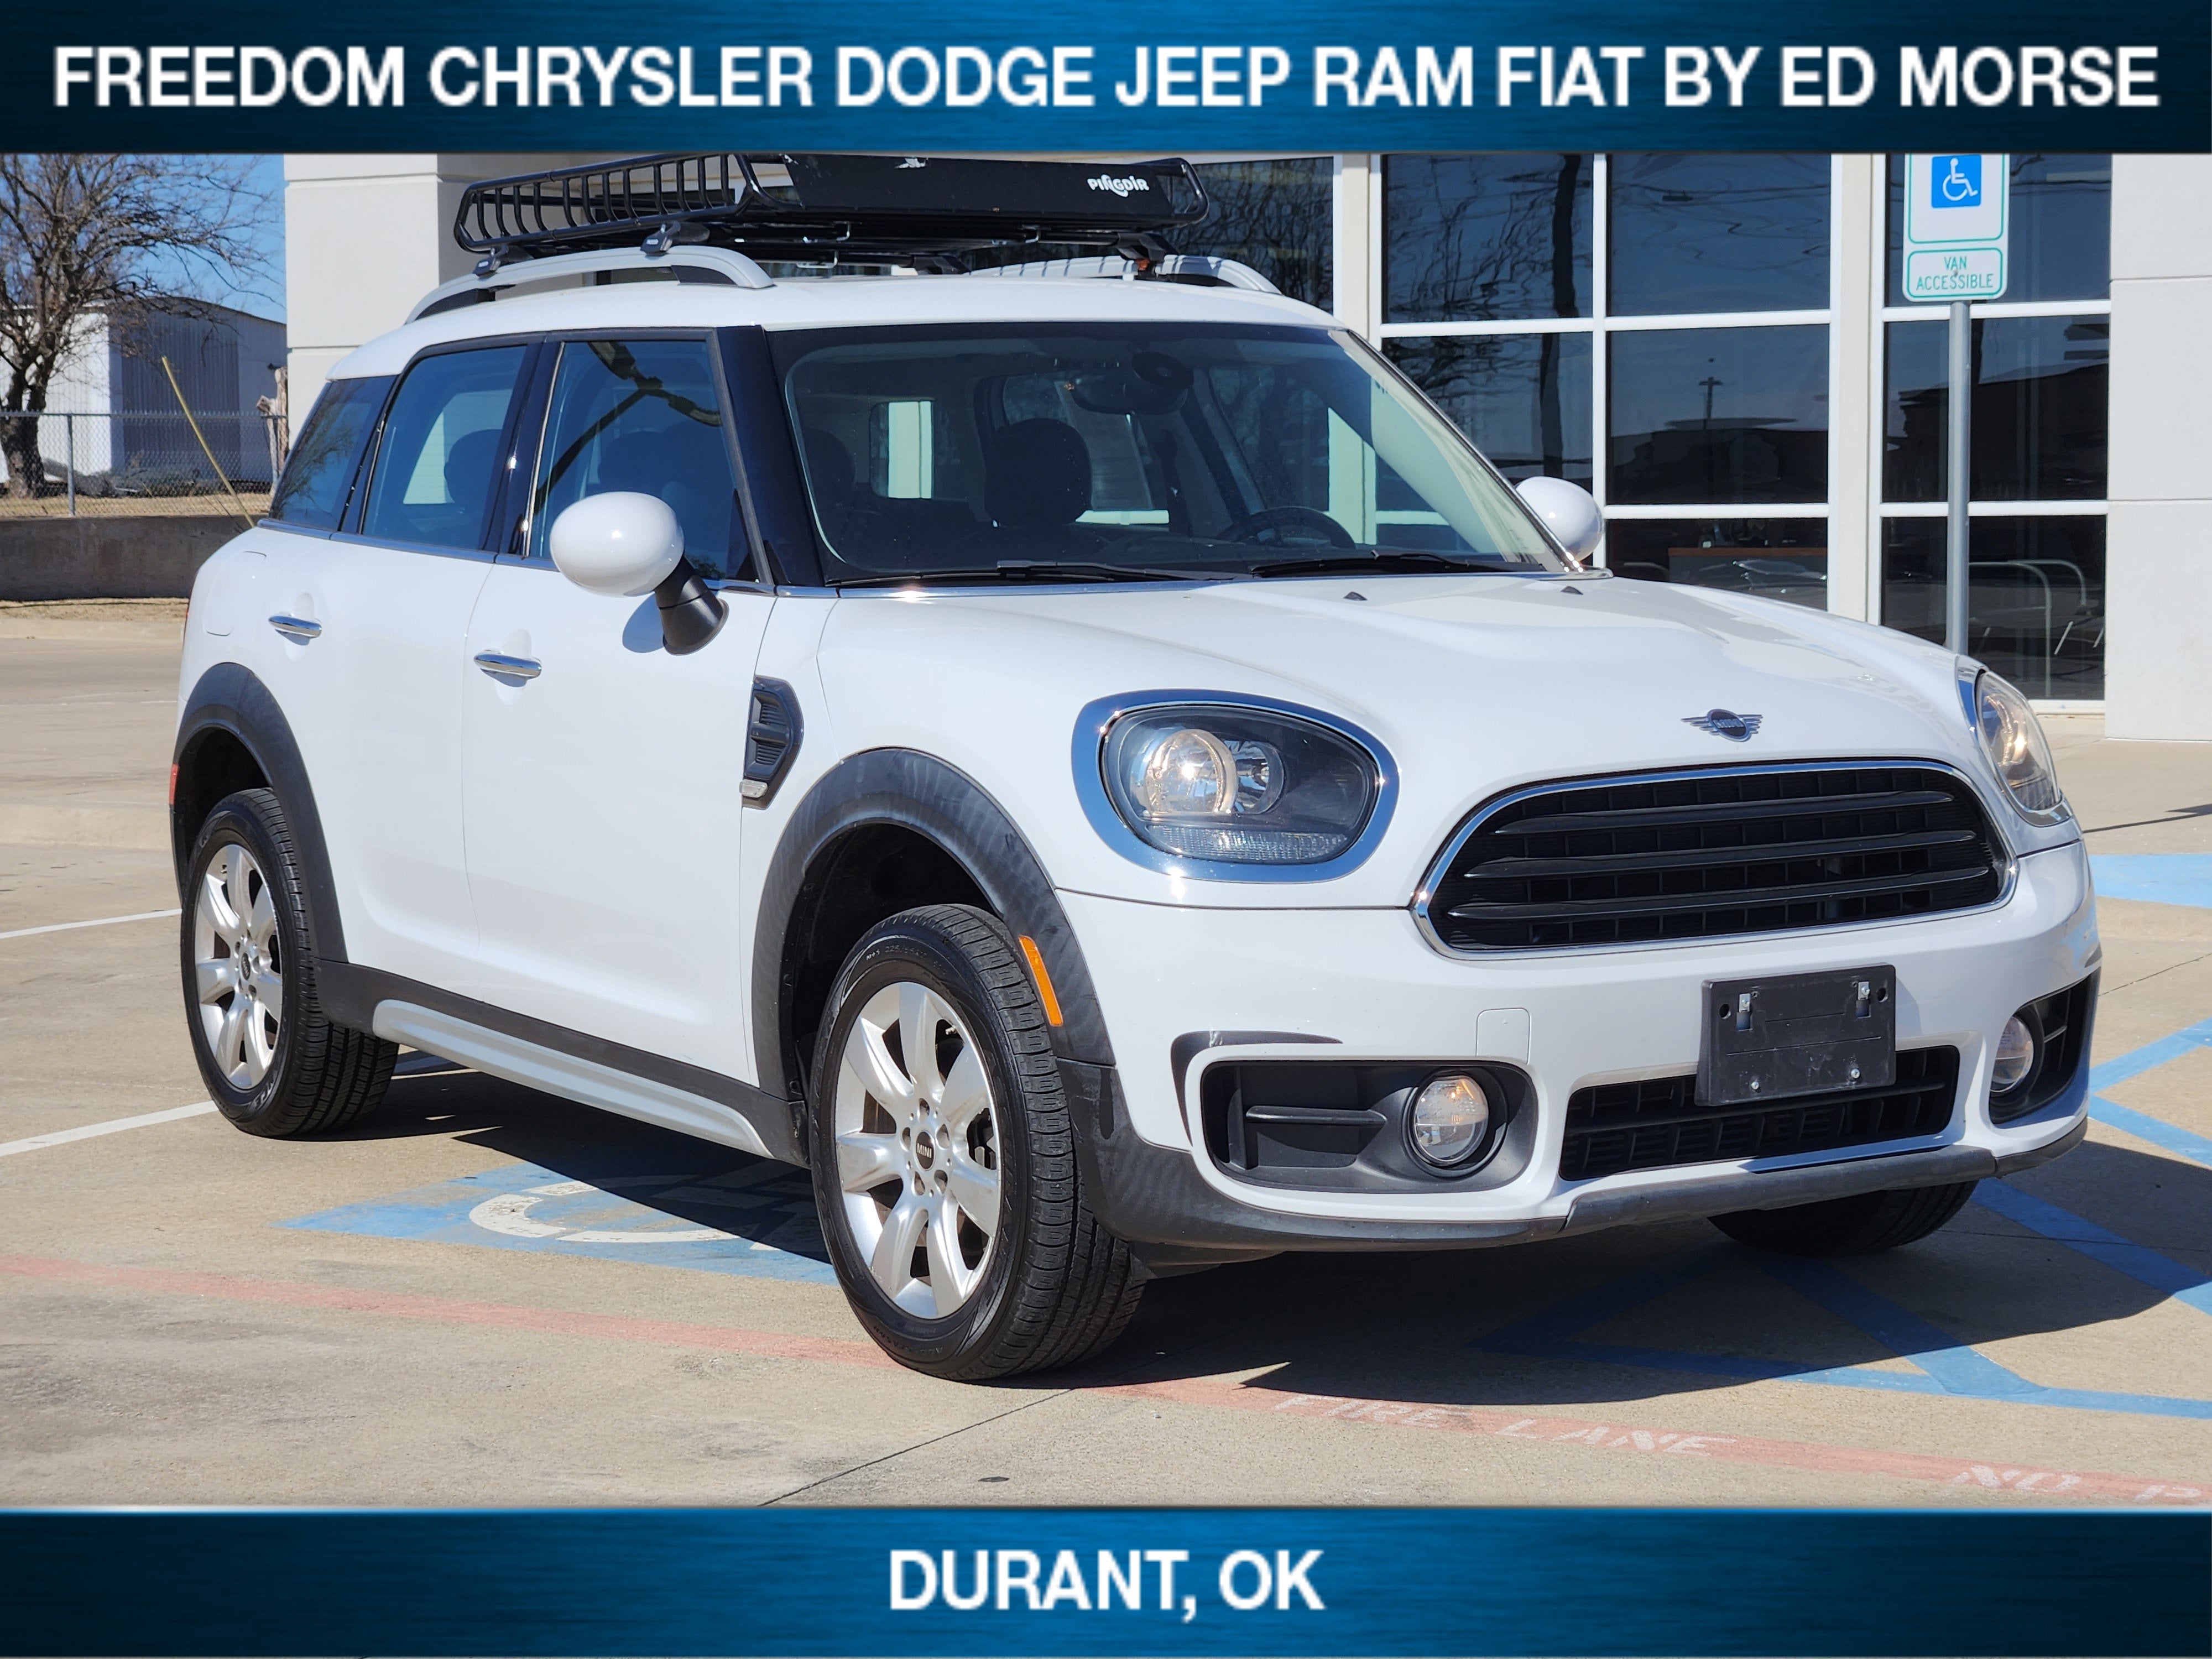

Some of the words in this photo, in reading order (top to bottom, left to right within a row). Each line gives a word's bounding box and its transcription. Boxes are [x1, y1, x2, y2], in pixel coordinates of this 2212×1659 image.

[1944, 256, 1967, 270] VAN
[1916, 273, 1994, 291] ACCESSIBLE
[917, 1142, 932, 1159] MINI
[1274, 1395, 1472, 1428] FIRE
[1496, 1418, 1738, 1456] LANE
[1950, 1465, 2081, 1492] NO
